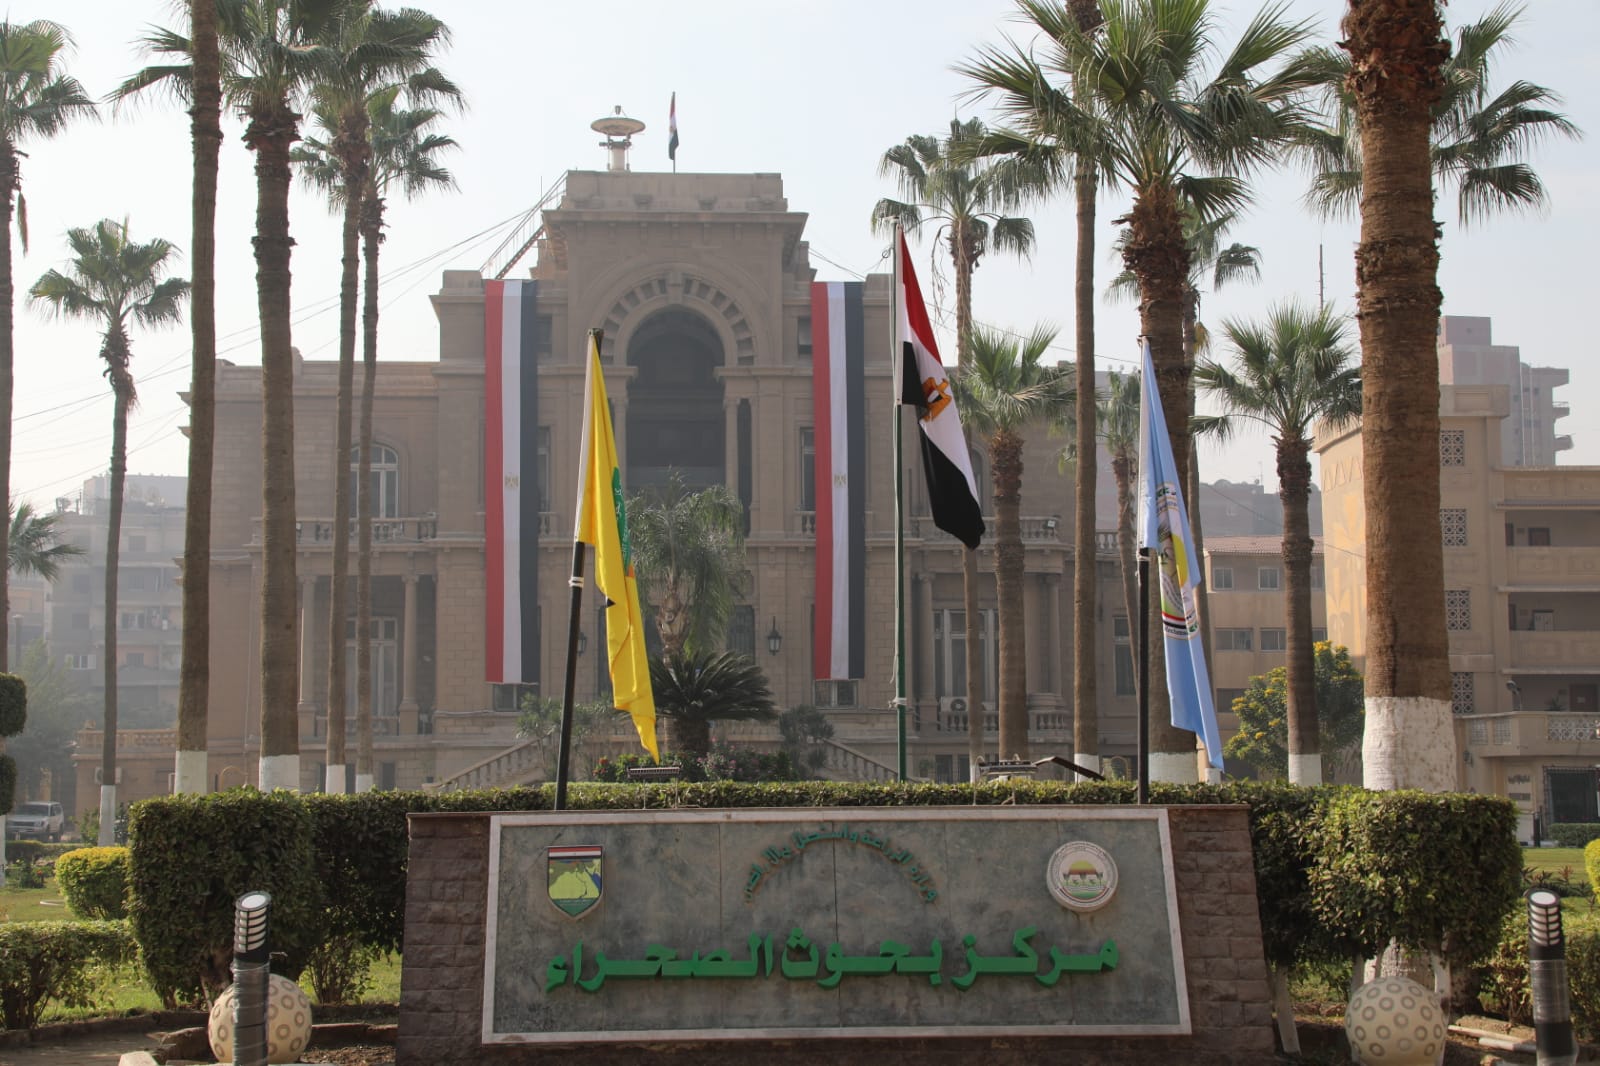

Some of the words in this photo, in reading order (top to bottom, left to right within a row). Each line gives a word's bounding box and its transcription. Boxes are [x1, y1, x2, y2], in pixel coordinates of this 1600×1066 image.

[860, 829, 914, 865] الزراعة
[545, 930, 775, 993] الصحراء
[781, 927, 943, 989] بحوث
[950, 925, 1120, 990] مركز
